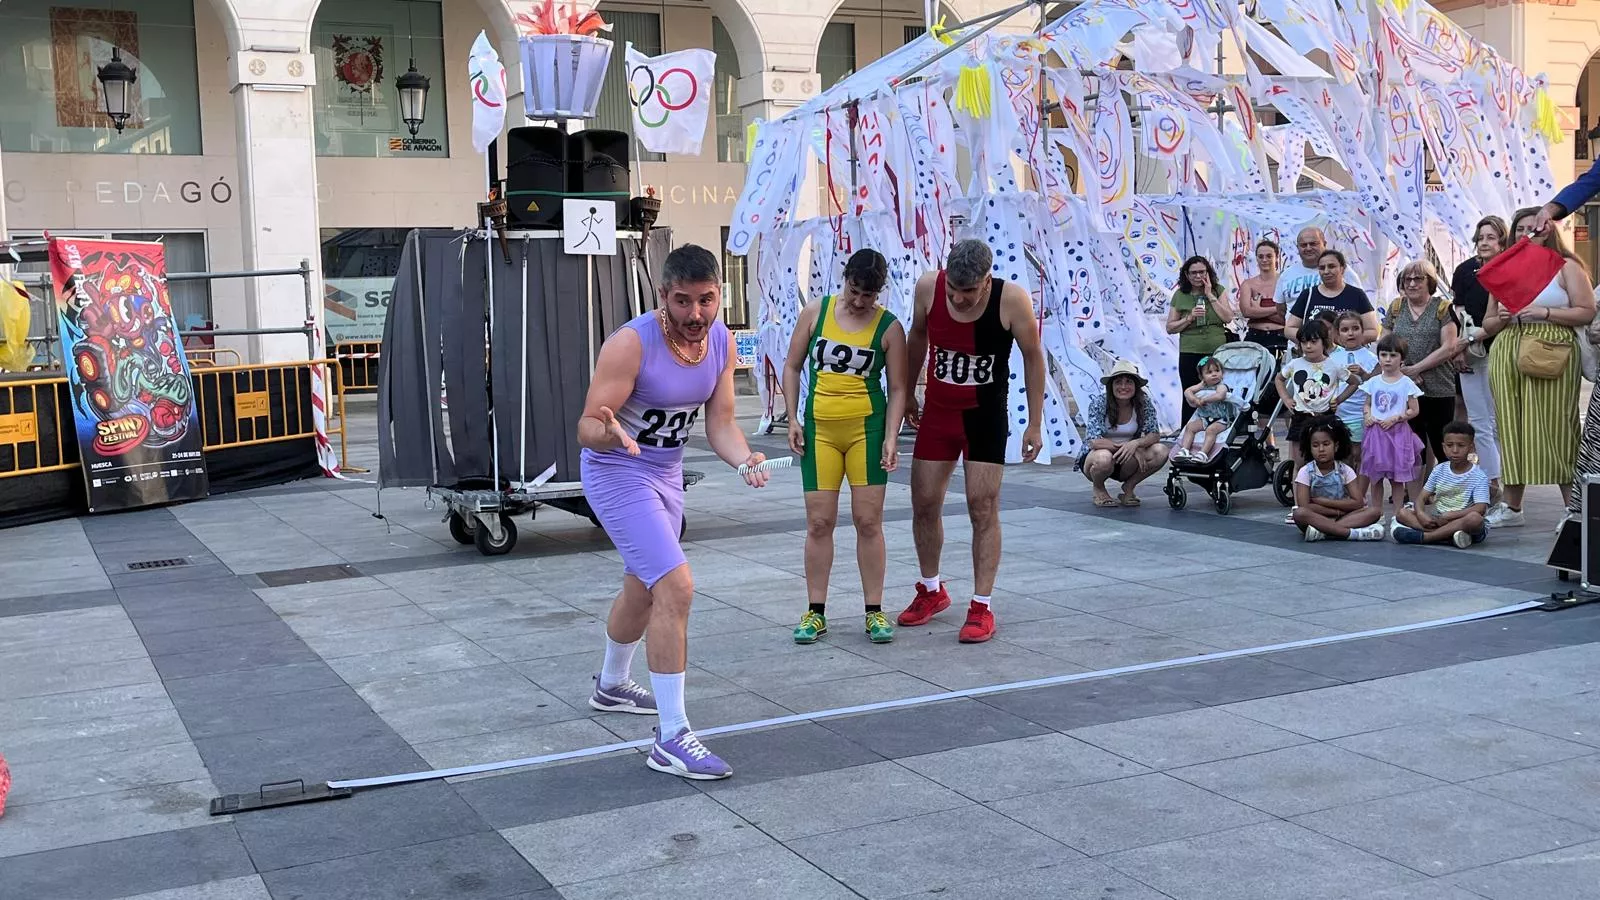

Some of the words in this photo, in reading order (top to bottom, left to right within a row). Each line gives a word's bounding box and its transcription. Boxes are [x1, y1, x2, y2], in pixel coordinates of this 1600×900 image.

[815, 339, 875, 376] 137
[935, 347, 993, 384] 808
[97, 417, 137, 436] SPIN
[103, 430, 139, 443] FESTIVAL
[91, 461, 113, 469] HUESCA
